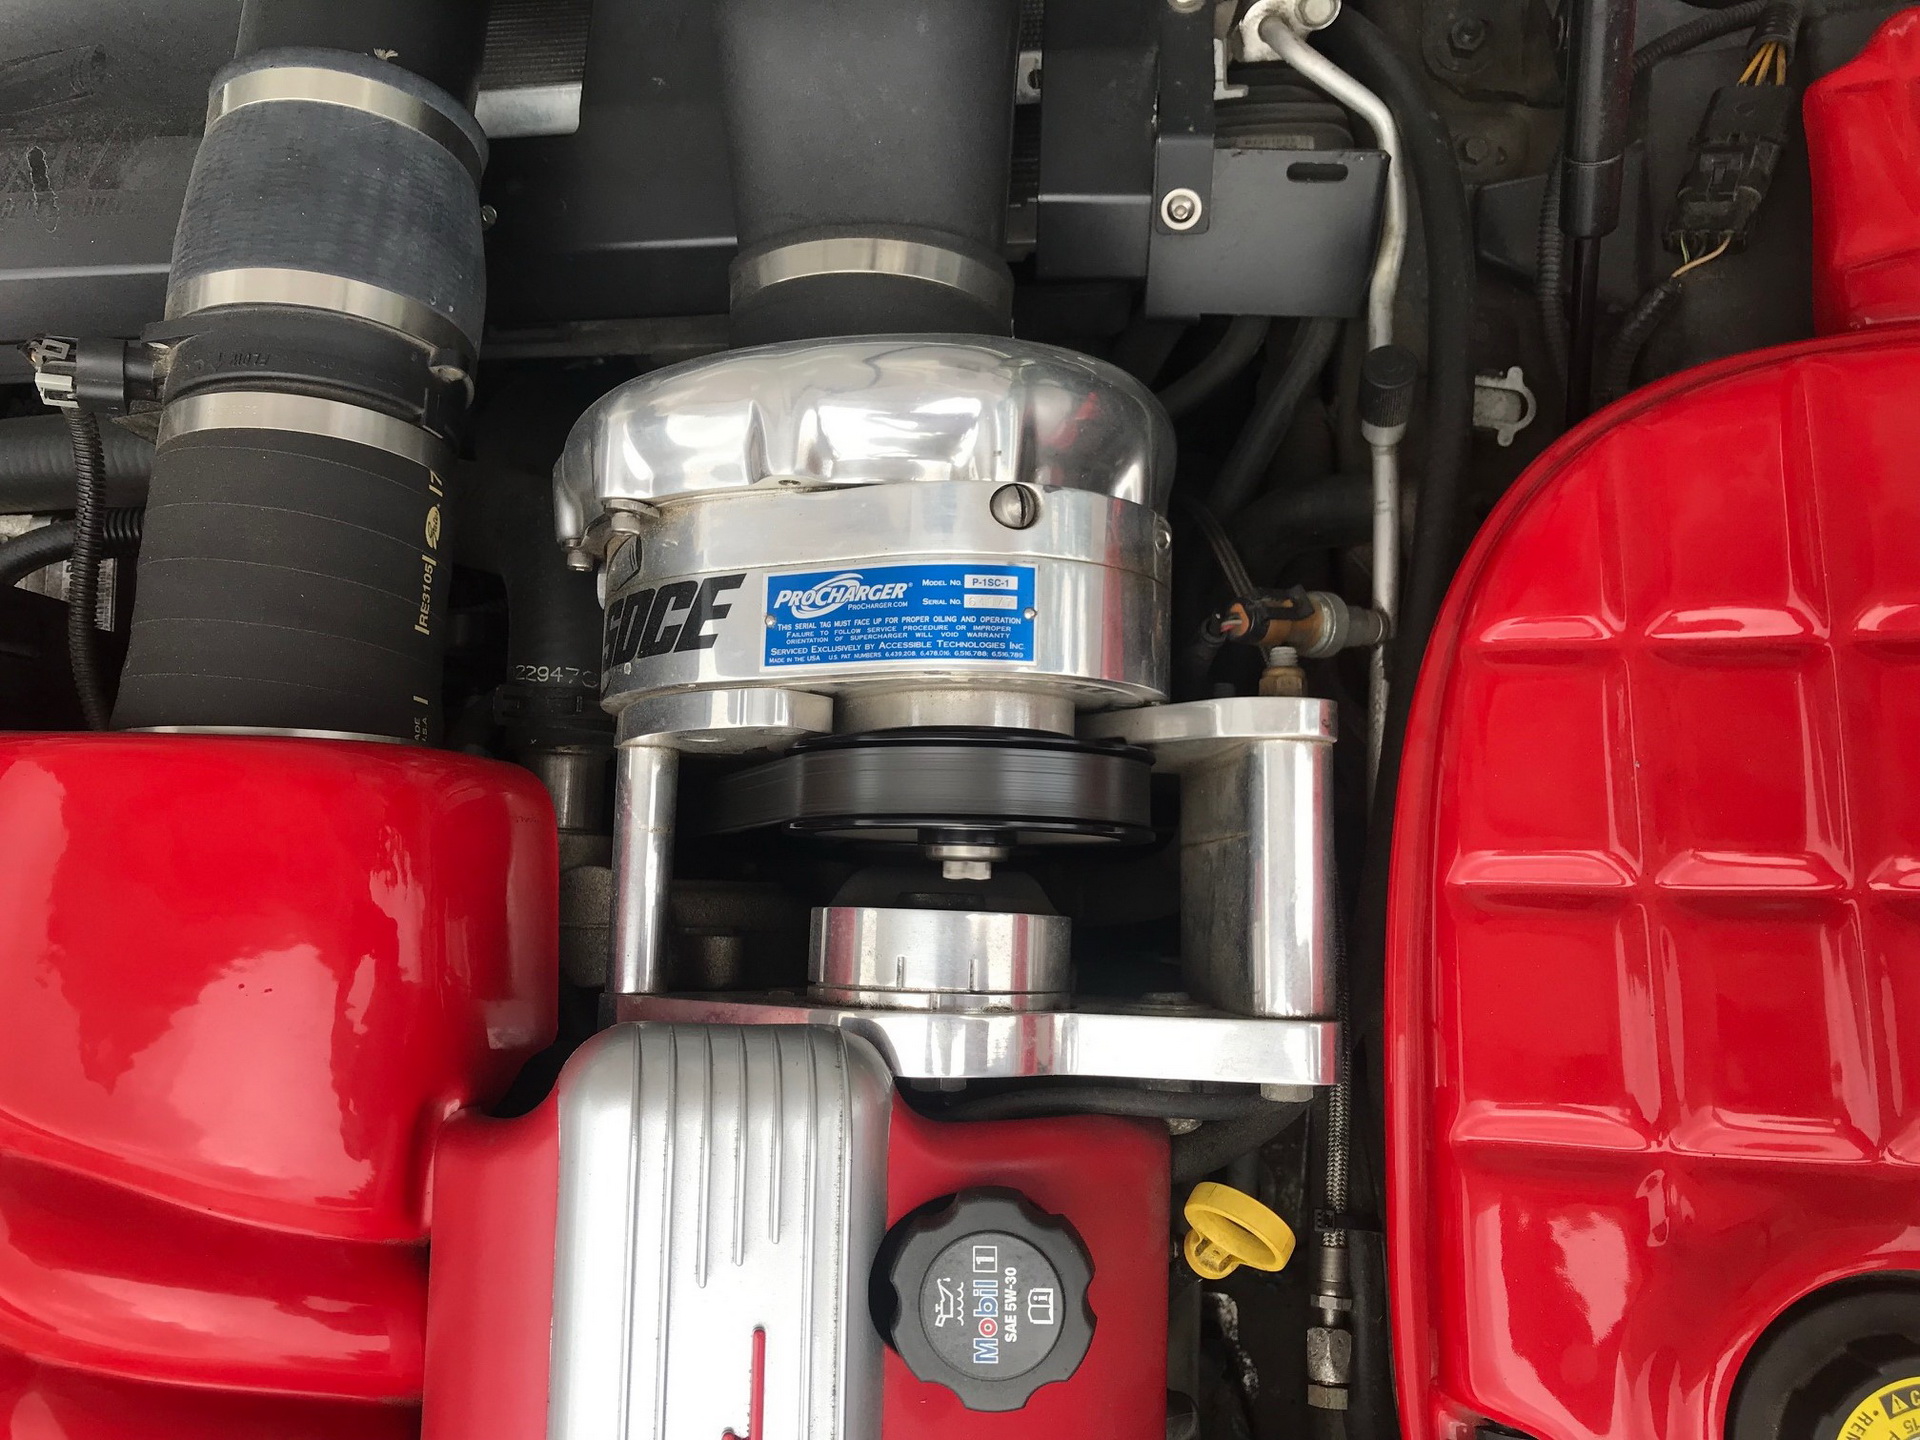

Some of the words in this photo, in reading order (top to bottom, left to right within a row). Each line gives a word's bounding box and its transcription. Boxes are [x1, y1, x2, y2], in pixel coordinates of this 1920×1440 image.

[922, 579, 947, 587] MODEL
[972, 577, 1009, 588] P-1SC-1
[418, 563, 434, 628] RE3105
[922, 597, 947, 606] SERIAL
[777, 623, 792, 632] THIS
[794, 621, 817, 630] SERIAL
[819, 620, 832, 629] TAG
[833, 619, 851, 628] MUST
[853, 618, 871, 627] FACE
[873, 617, 883, 625] UP
[885, 616, 899, 624] FOR
[901, 615, 930, 623] PROPER
[932, 615, 957, 623] OILING
[979, 616, 1022, 625] OPERATION
[786, 630, 815, 638] FAILURE
[866, 625, 897, 633] SERVICE
[786, 637, 829, 645] ORIENTATION
[850, 632, 908, 641] SUPERCHARGER
[770, 647, 808, 656] SERVICED
[811, 644, 861, 654] EXCLUSIVELY
[878, 641, 932, 649] ACCESSIBLE
[936, 639, 1006, 649] TECHNOLOGIES
[1009, 641, 1024, 651] INC
[1004, 1267, 1018, 1312] 5W-30
[973, 1279, 999, 1364] Mobil
[1004, 1314, 1018, 1343] SAE
